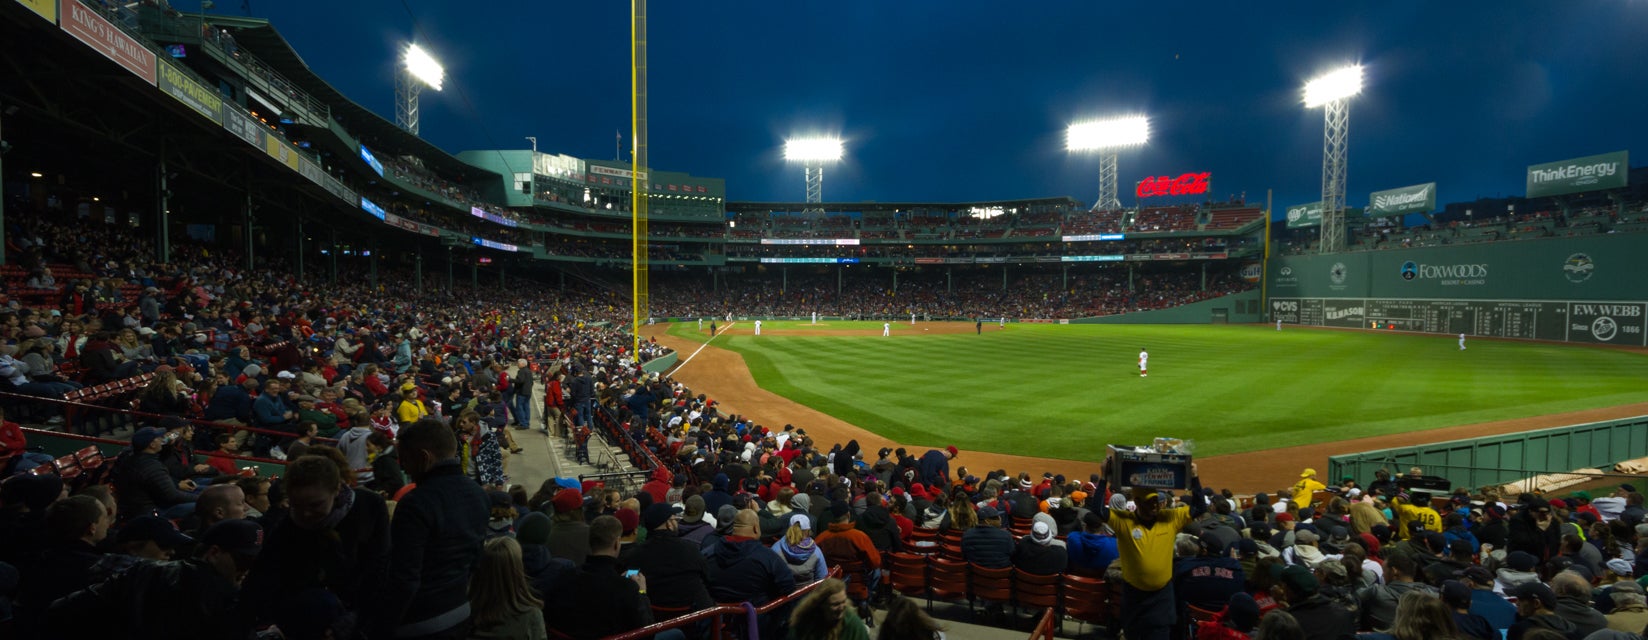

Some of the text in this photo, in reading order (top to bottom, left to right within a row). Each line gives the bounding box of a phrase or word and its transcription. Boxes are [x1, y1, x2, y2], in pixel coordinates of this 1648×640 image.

[72, 4, 148, 66] KING'S HAWAIIAN
[160, 64, 221, 113] 1-800-PAVEMENT
[594, 166, 622, 177] FENWAY
[1532, 162, 1616, 183] ThinkEnergy
[1136, 172, 1211, 198] Coca-Cola
[1386, 188, 1428, 206] National
[1241, 266, 1260, 277] Gulf
[1419, 264, 1488, 279] FOXWOODS
[1280, 301, 1298, 312] CVS
[1599, 305, 1641, 317] WEBB
[1273, 311, 1298, 323] Health
[1622, 325, 1640, 333] 1866
[1418, 513, 1434, 525] 118
[1191, 566, 1211, 577] RED
